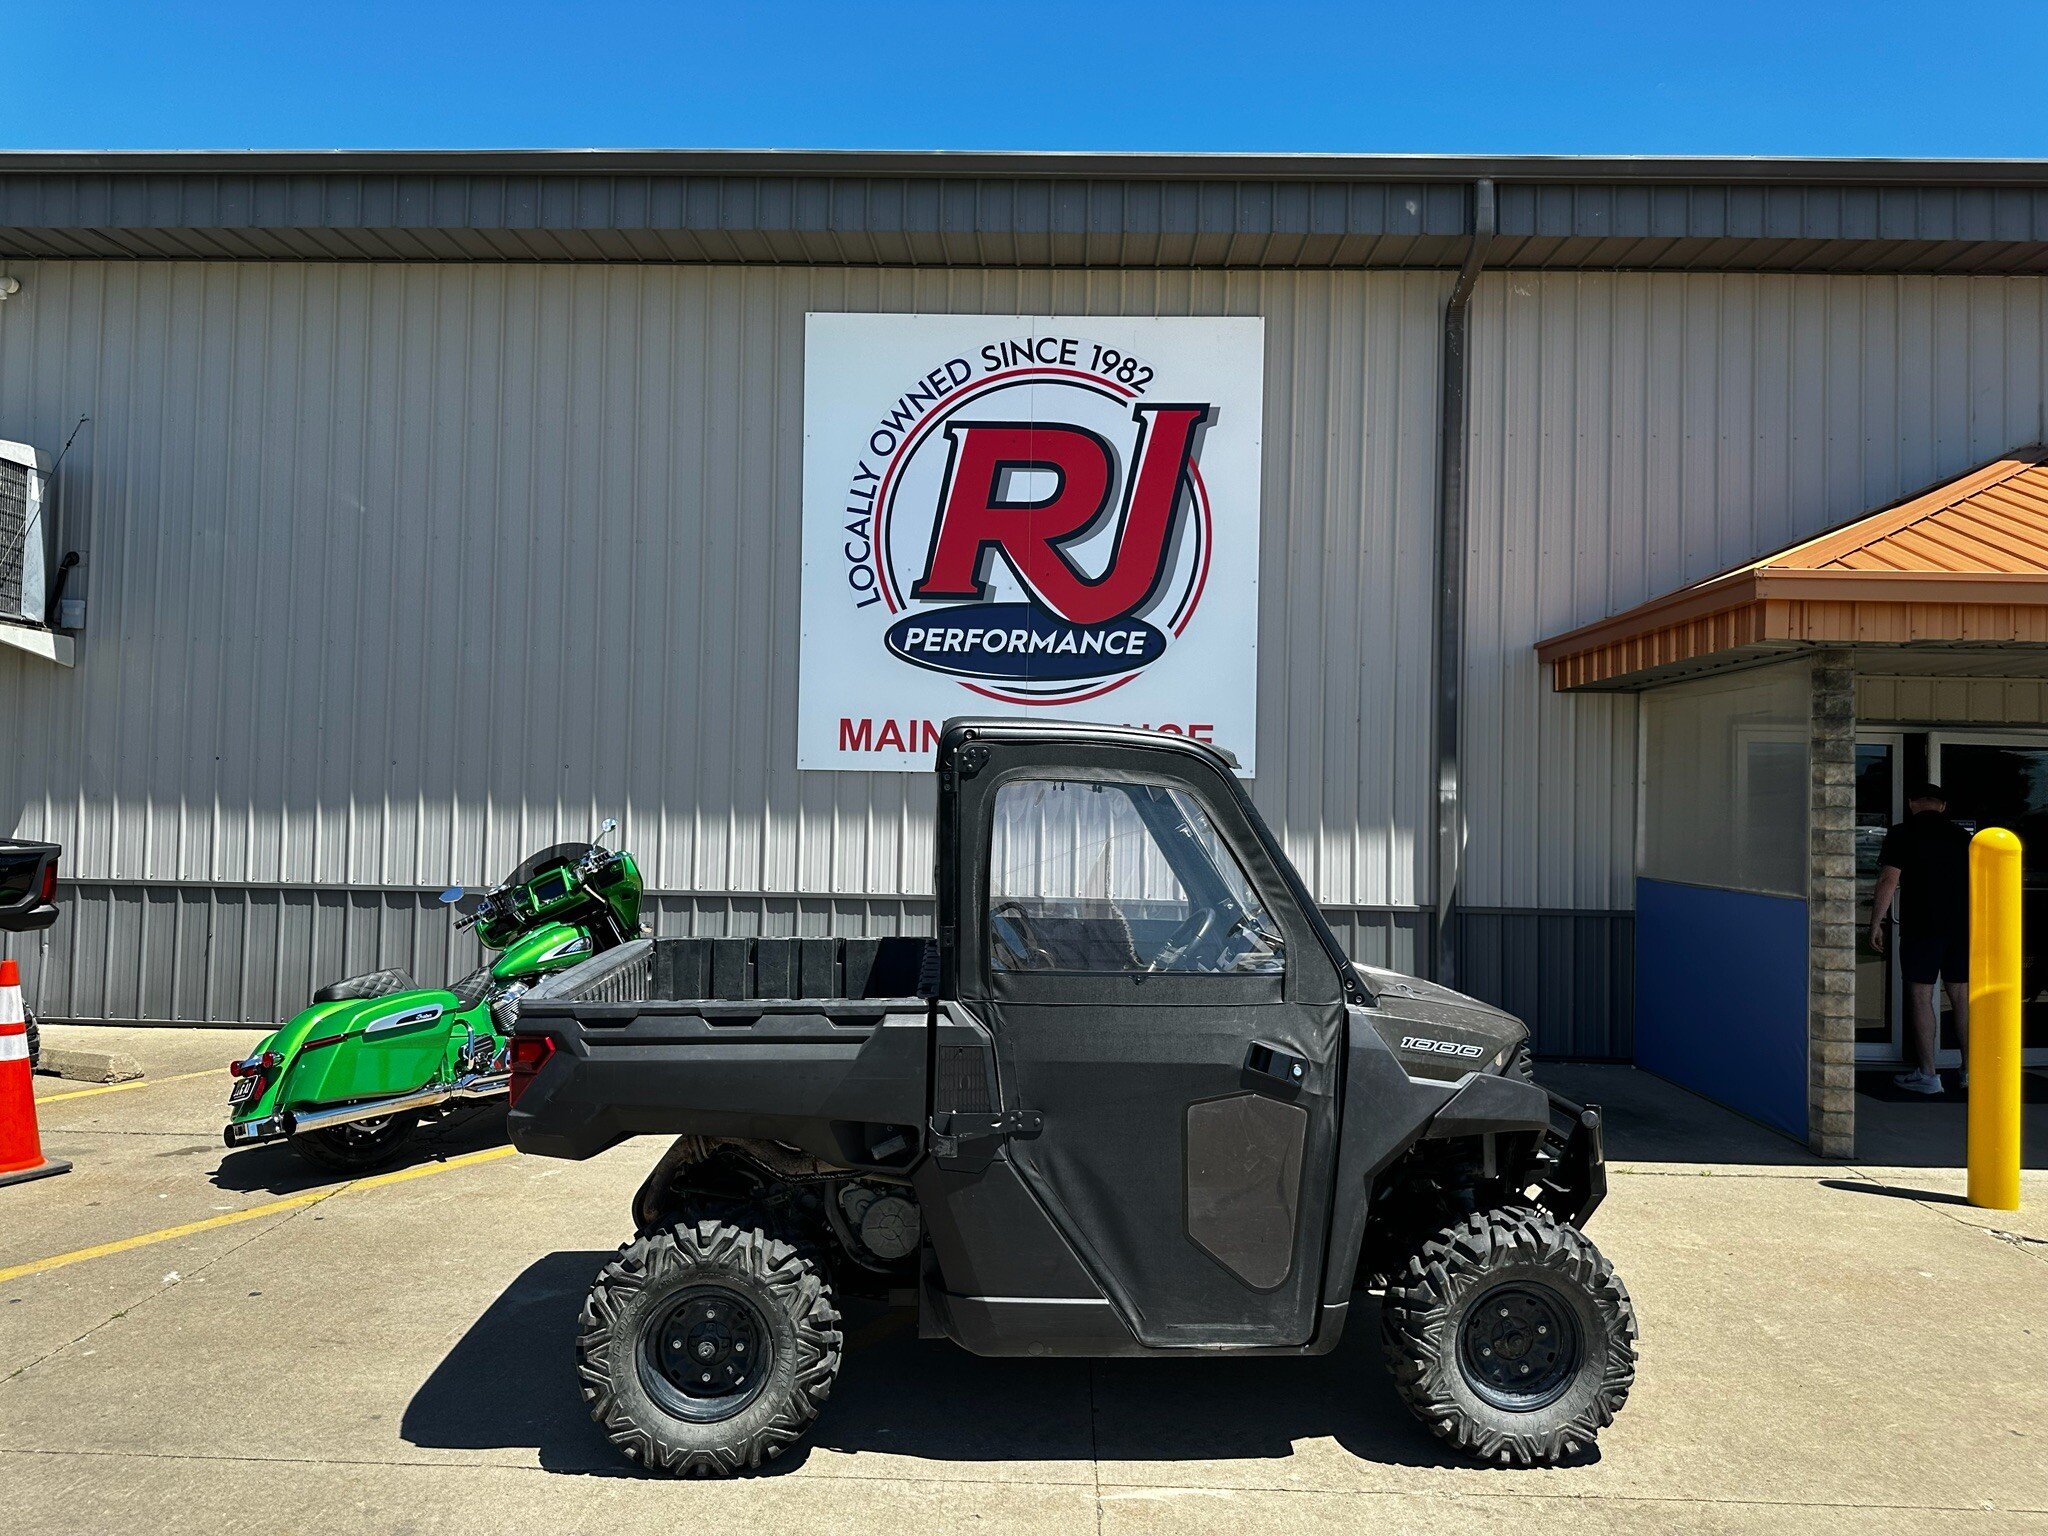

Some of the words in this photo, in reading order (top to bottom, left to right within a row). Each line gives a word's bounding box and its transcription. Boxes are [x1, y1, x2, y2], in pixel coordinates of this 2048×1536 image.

[844, 459, 882, 609] LOCALLY
[869, 358, 972, 457] OWNED
[980, 337, 1079, 372] SINCE
[1090, 344, 1154, 394] 1982
[910, 402, 1213, 625] RJ
[903, 627, 1148, 655] PERFORMANCE
[1400, 1036, 1484, 1058] 1000
